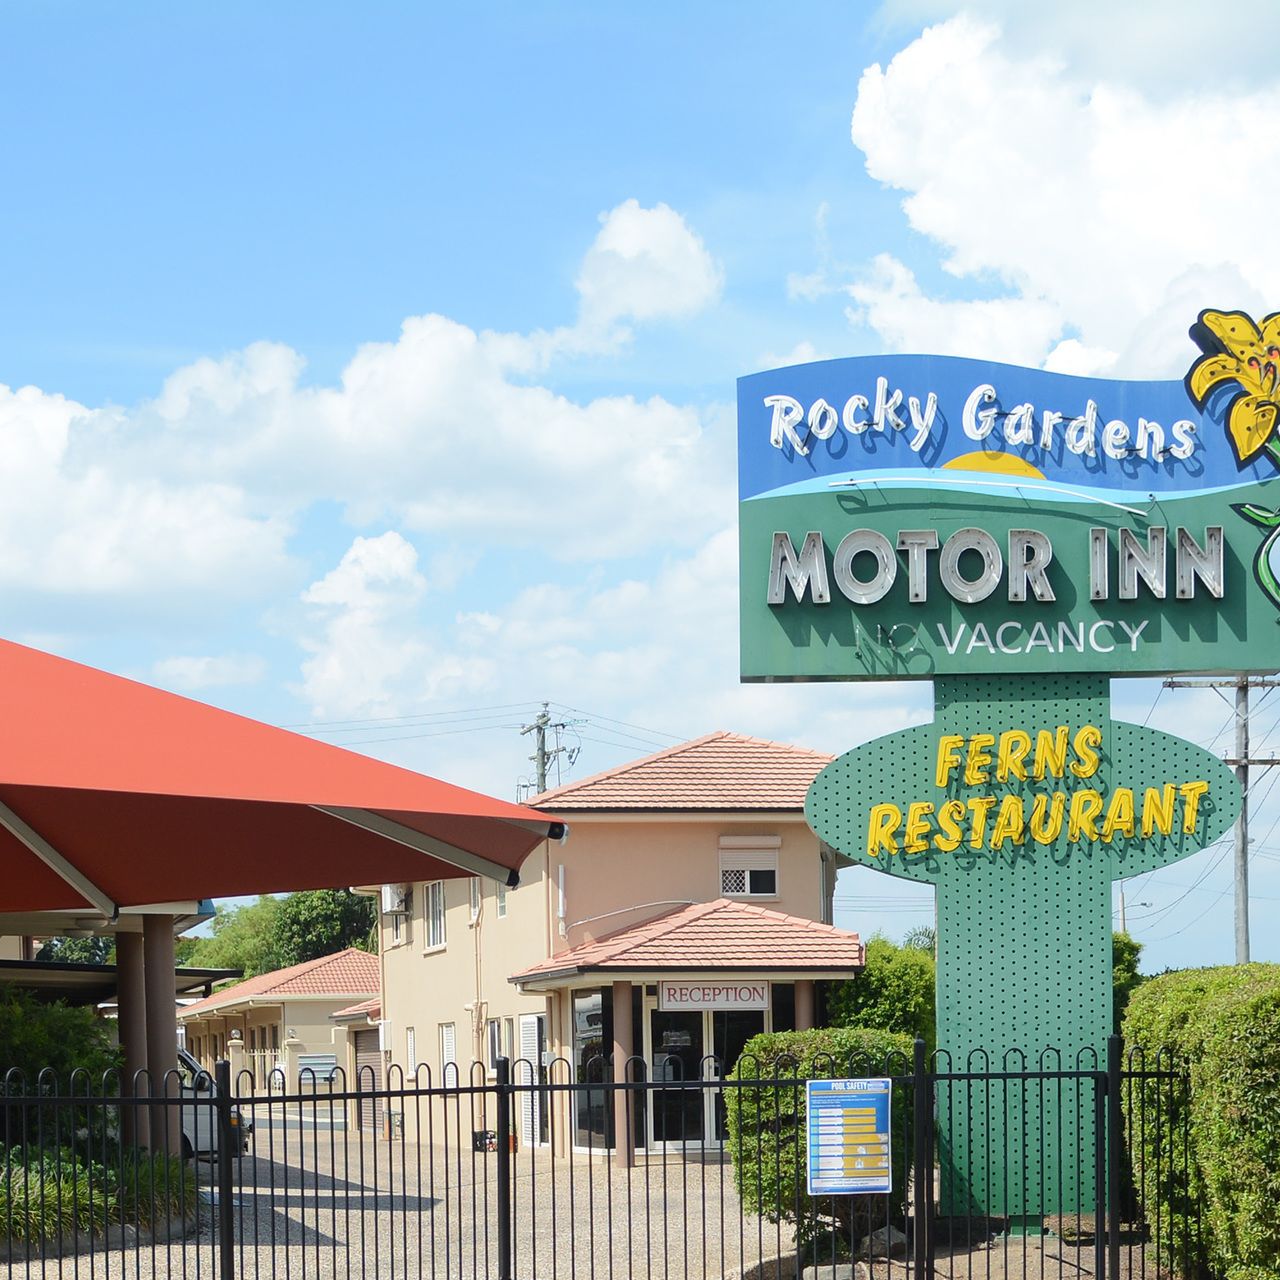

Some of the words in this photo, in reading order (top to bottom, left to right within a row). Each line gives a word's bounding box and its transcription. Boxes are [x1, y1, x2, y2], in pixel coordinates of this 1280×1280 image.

[763, 376, 937, 455] Rocky
[963, 384, 1198, 461] Gardens
[767, 528, 1056, 605] MOTOR
[1089, 526, 1224, 601] INN
[936, 620, 1149, 655] VACANCY
[935, 725, 1102, 788] FERNS
[867, 781, 1209, 857] RESTAURANT
[667, 986, 765, 1003] RECEPTION
[831, 1082, 846, 1090] POOL
[846, 1081, 867, 1090] SAFETY
